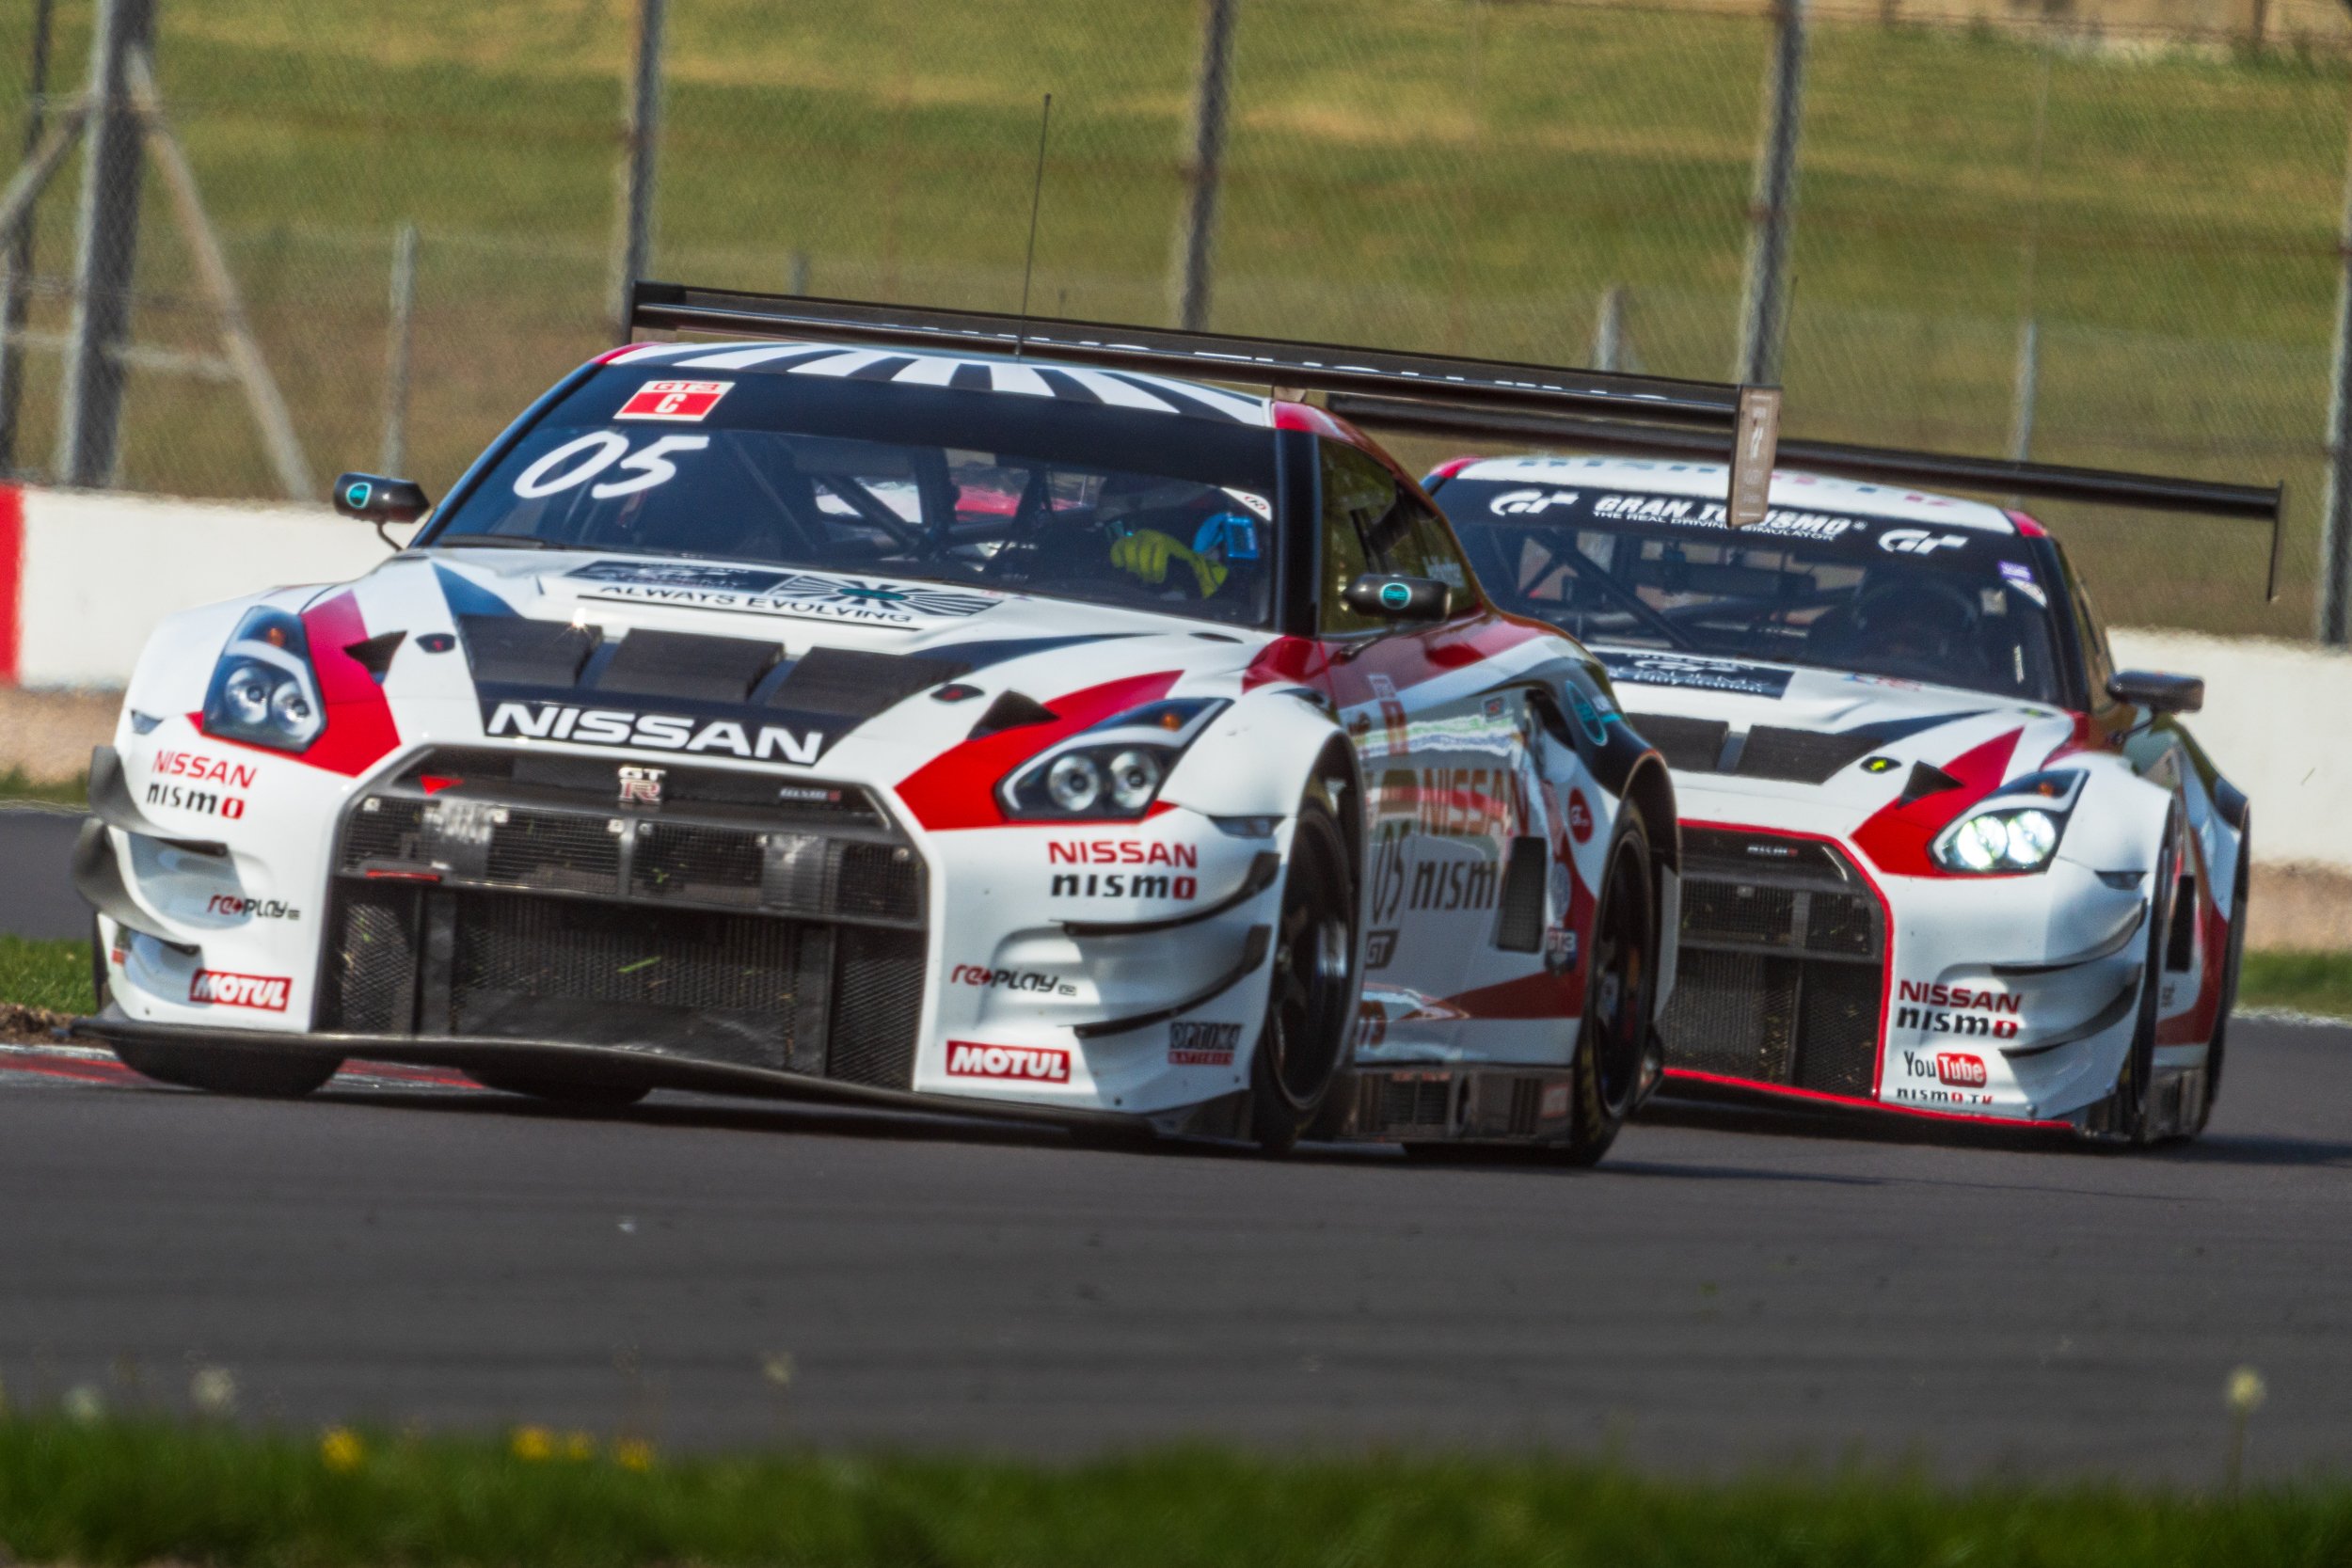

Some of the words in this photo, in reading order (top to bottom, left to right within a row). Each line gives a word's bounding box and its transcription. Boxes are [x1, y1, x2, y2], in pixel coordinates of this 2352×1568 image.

[653, 382, 720, 390] GT3
[654, 393, 687, 413] C
[513, 432, 709, 499] 05
[1593, 510, 1622, 519] THE
[1627, 514, 1666, 524] REAL
[1740, 526, 1836, 542] SIMULATOR
[1594, 495, 1693, 517] GRAN
[1698, 503, 1851, 535] TISMO
[598, 586, 737, 605] ALWAYS
[747, 596, 913, 624] EVOLVING
[488, 703, 824, 764] NISSAN
[152, 750, 258, 789] NISSAN
[146, 782, 246, 819] nismo
[1422, 768, 1531, 837] NISSAN
[1049, 840, 1198, 868] NISSAN
[1050, 874, 1197, 900] nismo
[1373, 820, 1409, 926] 05
[195, 974, 286, 1006] MOTUL
[1899, 979, 2022, 1014] NISSAN
[1897, 1006, 2018, 1038] nismo
[950, 1046, 1066, 1079] MOTUL
[1904, 1051, 1985, 1084] YouTube
